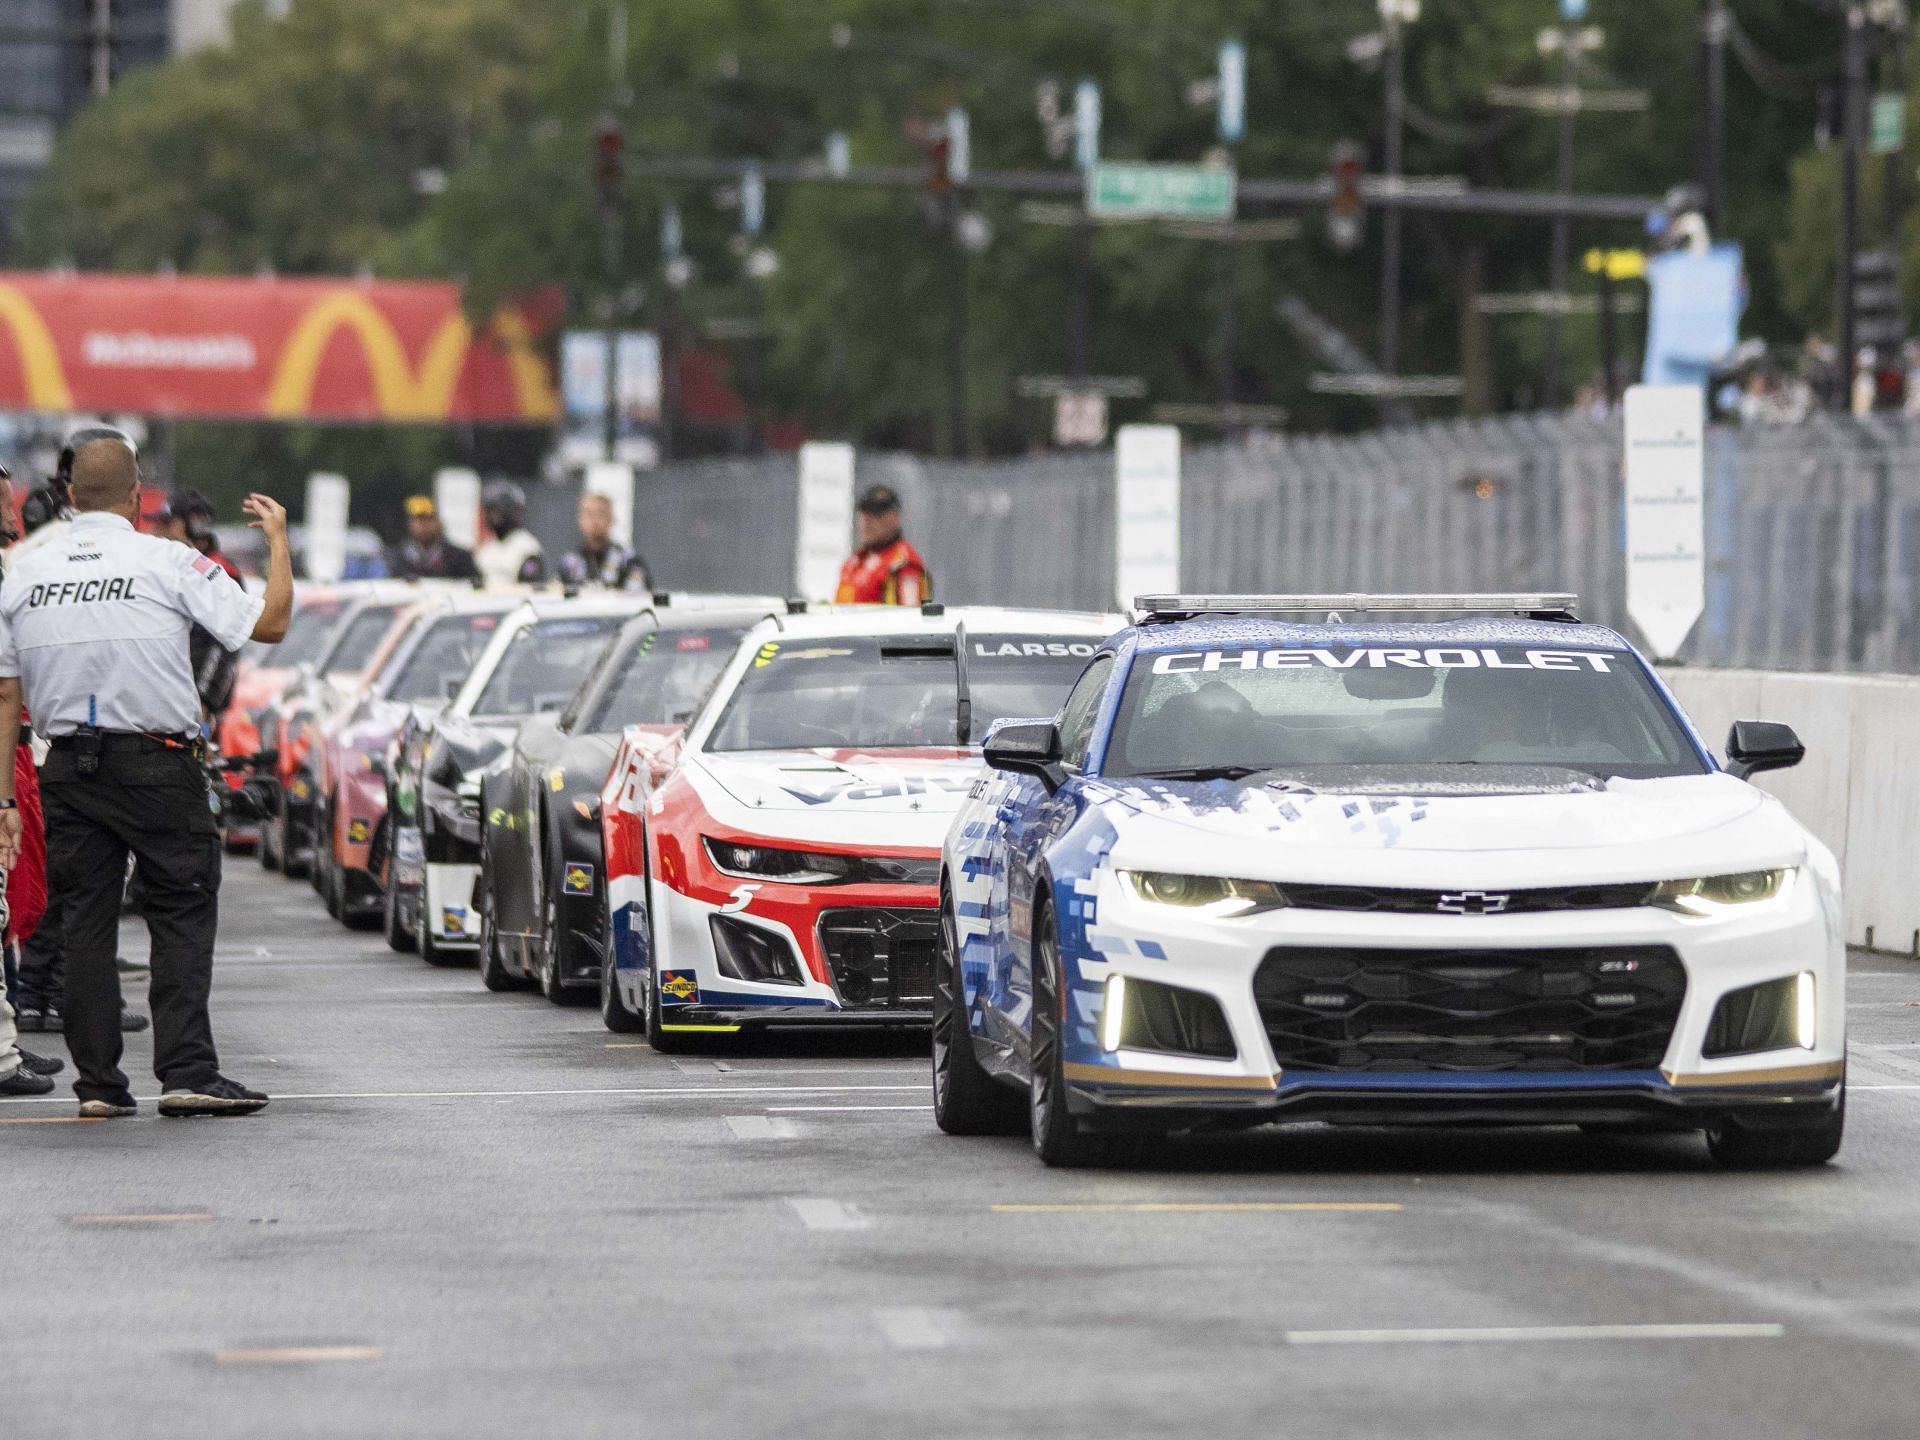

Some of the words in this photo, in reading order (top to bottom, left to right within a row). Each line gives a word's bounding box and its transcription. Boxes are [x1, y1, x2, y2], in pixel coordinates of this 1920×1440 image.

[29, 577, 137, 608] OFFICIAL
[974, 642, 1104, 657] LARSO
[1152, 648, 1616, 675] CHEVROLET
[718, 883, 763, 913] 5
[661, 981, 697, 994] SUNOCO
